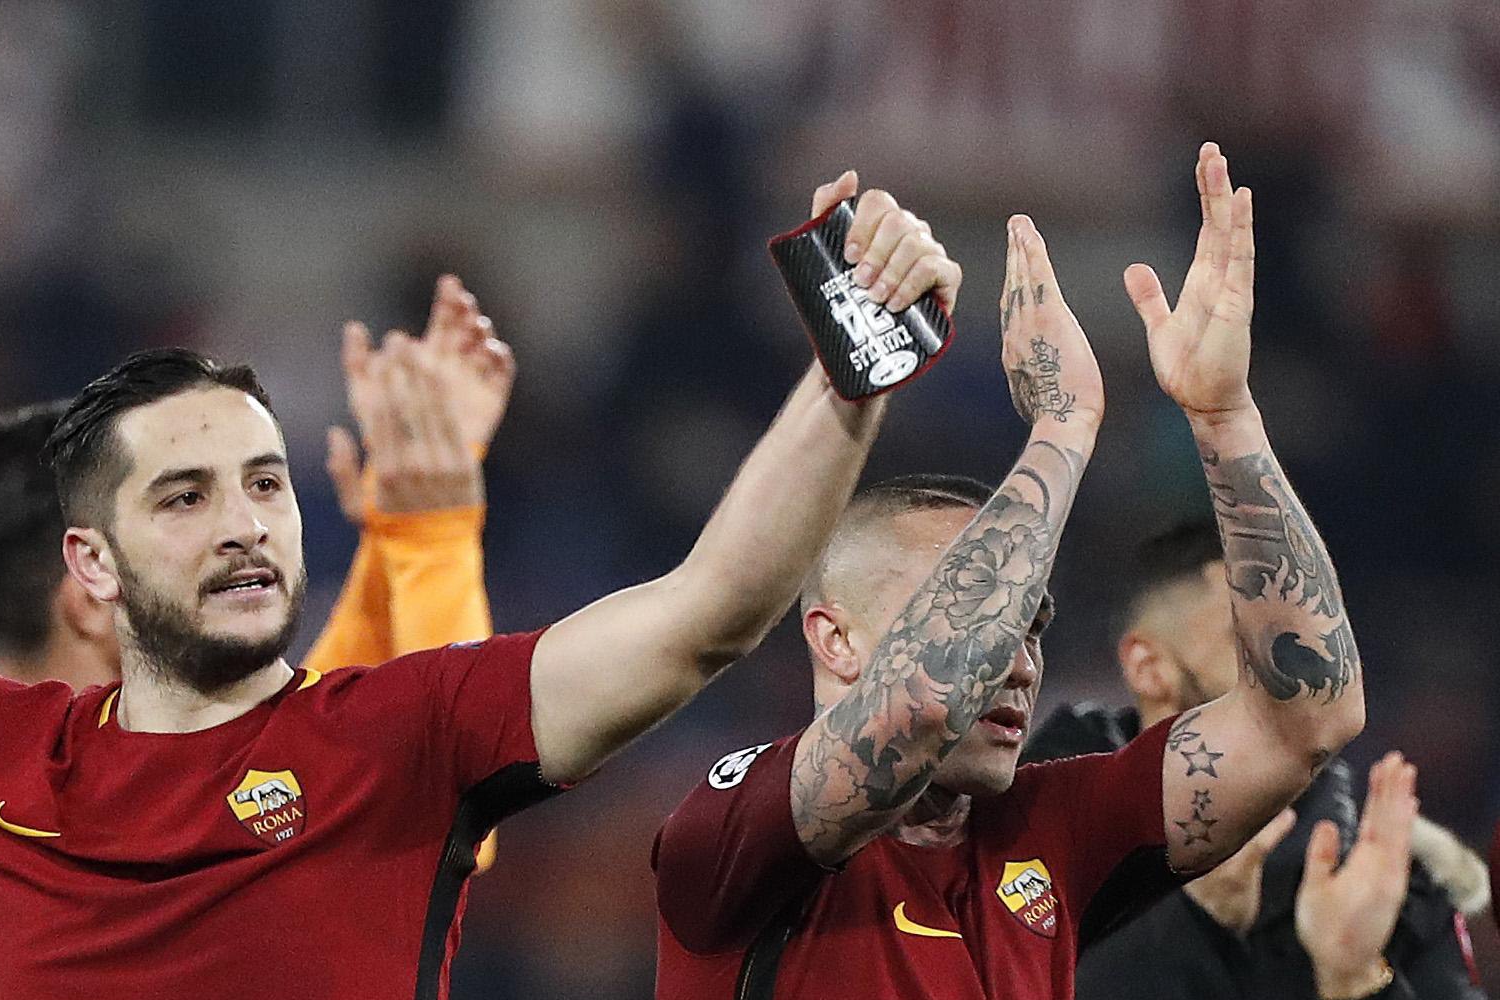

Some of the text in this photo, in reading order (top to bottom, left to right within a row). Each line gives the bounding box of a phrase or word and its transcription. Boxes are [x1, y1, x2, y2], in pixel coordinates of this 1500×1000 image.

[252, 806, 303, 836] ROMA
[275, 827, 294, 841] 1927
[1023, 894, 1058, 925] ROMA
